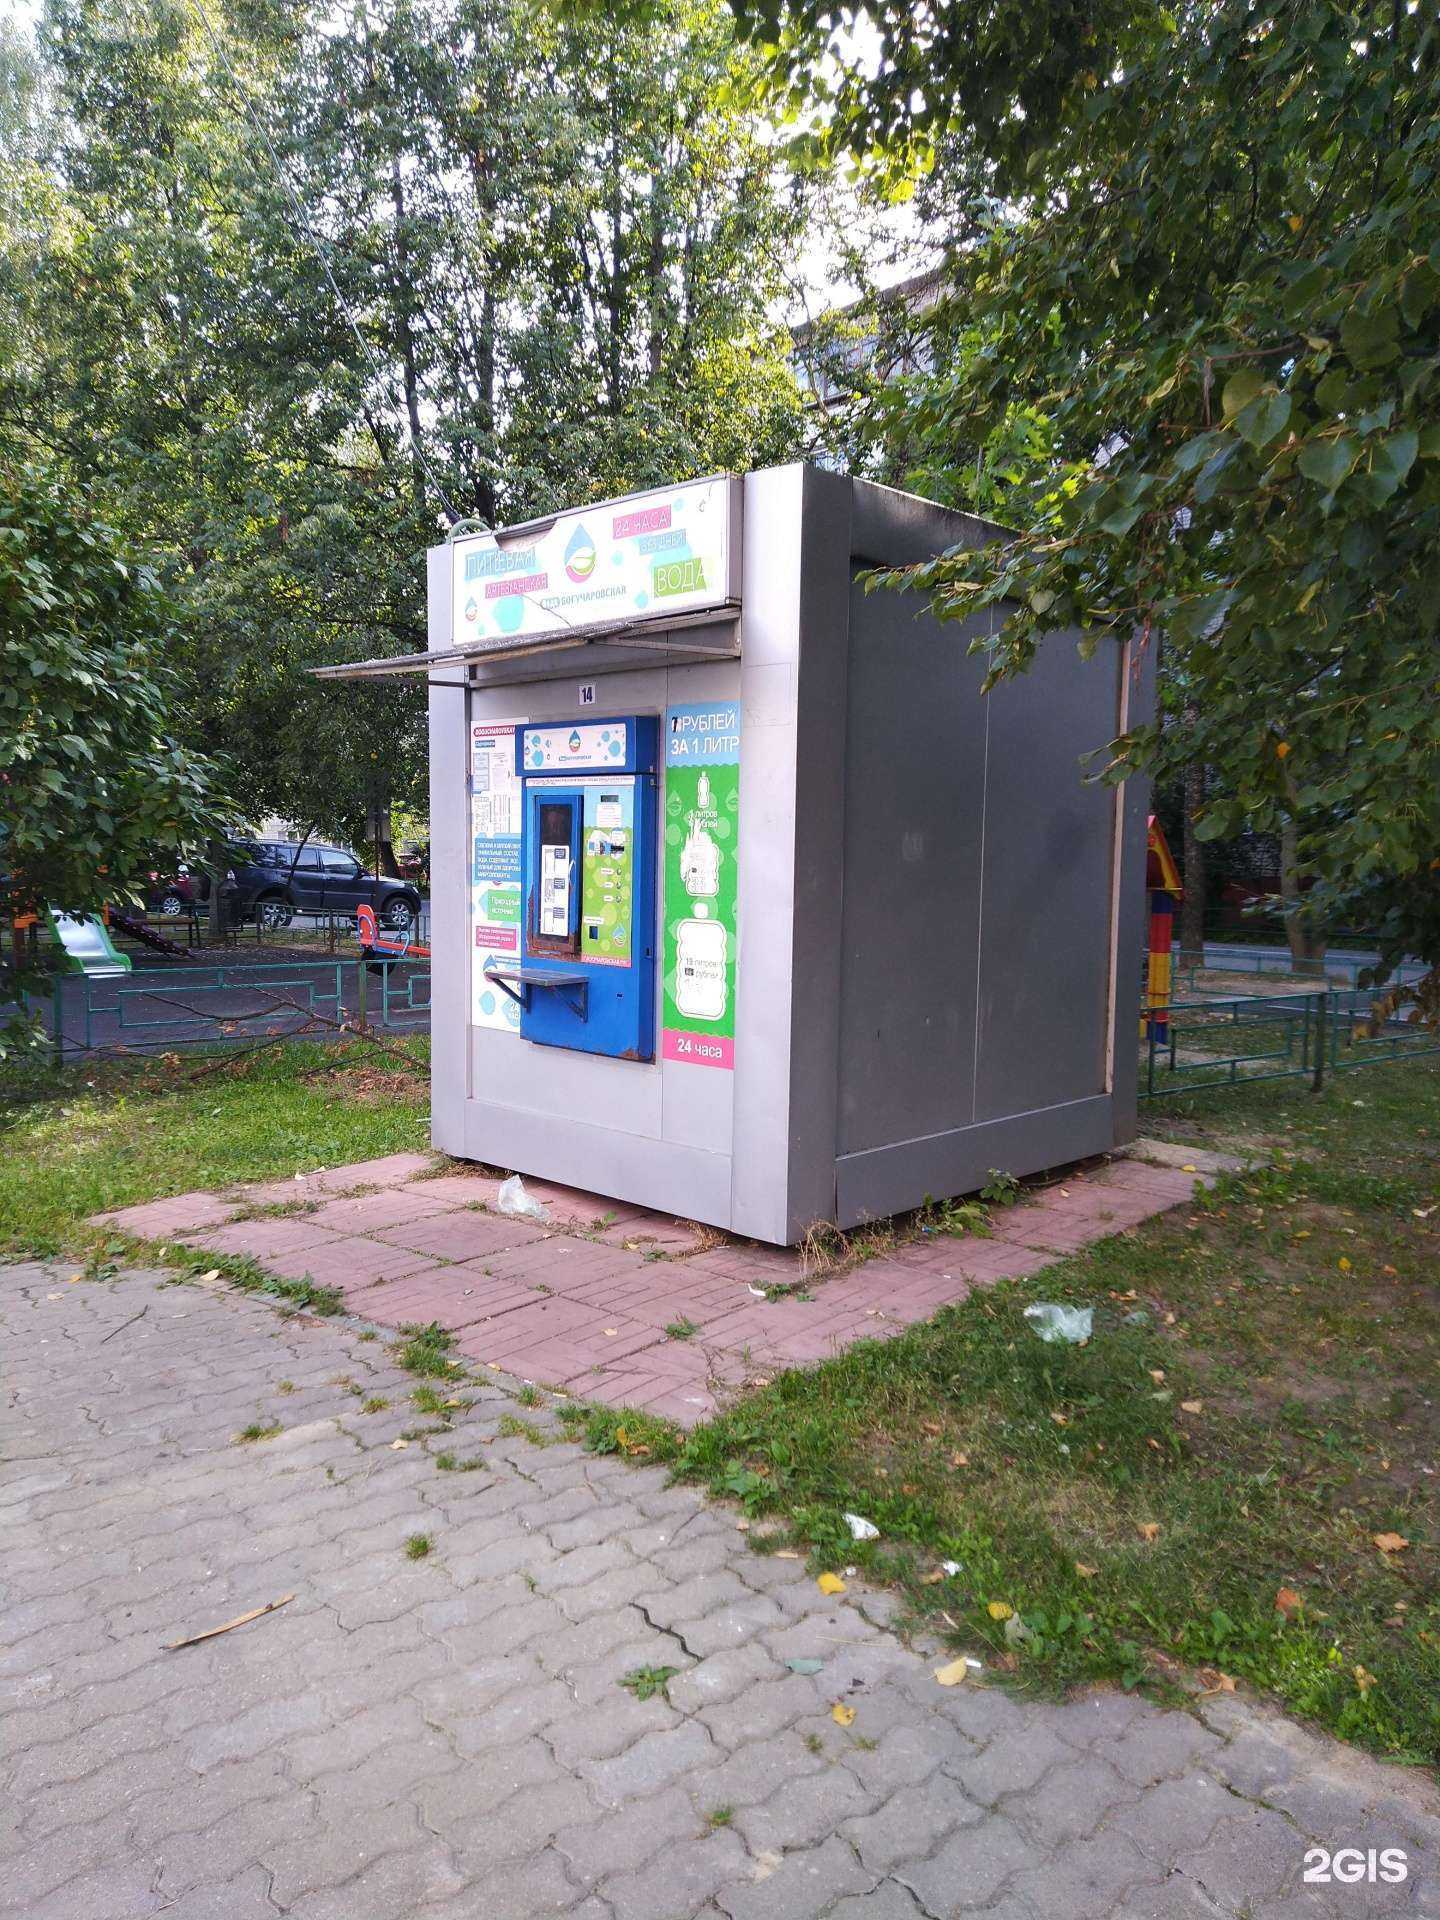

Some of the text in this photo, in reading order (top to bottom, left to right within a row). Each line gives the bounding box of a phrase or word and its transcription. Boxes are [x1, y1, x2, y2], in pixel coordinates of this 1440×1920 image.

[657, 561, 707, 592] ВОДА
[561, 585, 627, 606] БОГУЧАРОВСКАЯ
[581, 686, 593, 702] 14
[683, 708, 736, 732] РУБЛЕЙ
[671, 735, 740, 755] ЗА 1 ЛИТР
[677, 1038, 723, 1059] 24 часа
